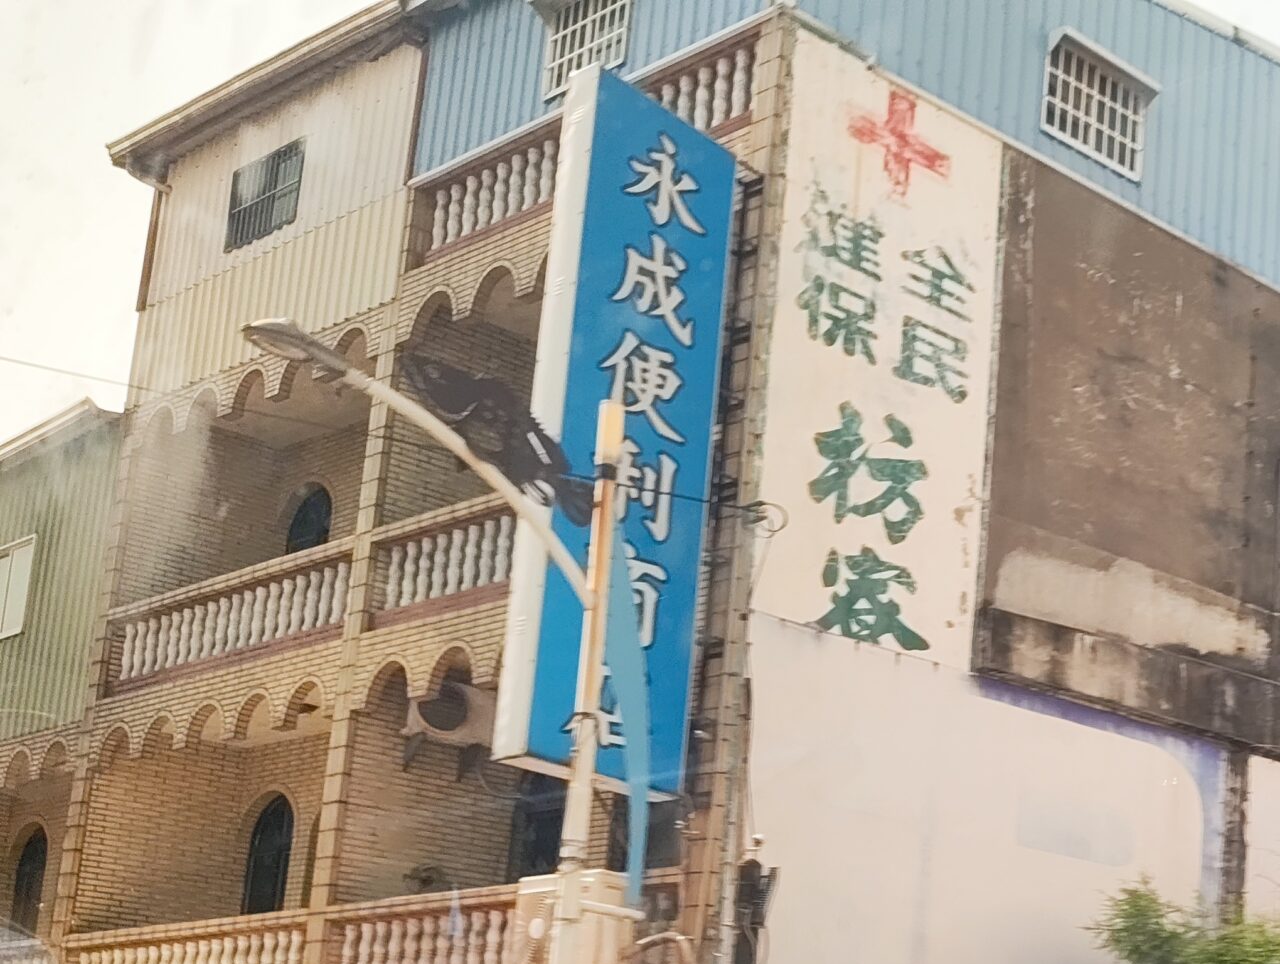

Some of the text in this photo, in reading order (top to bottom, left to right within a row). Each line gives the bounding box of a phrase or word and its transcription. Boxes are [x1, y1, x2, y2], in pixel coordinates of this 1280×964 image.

[562, 133, 707, 749] 永成便利
[892, 245, 978, 404] 全民
